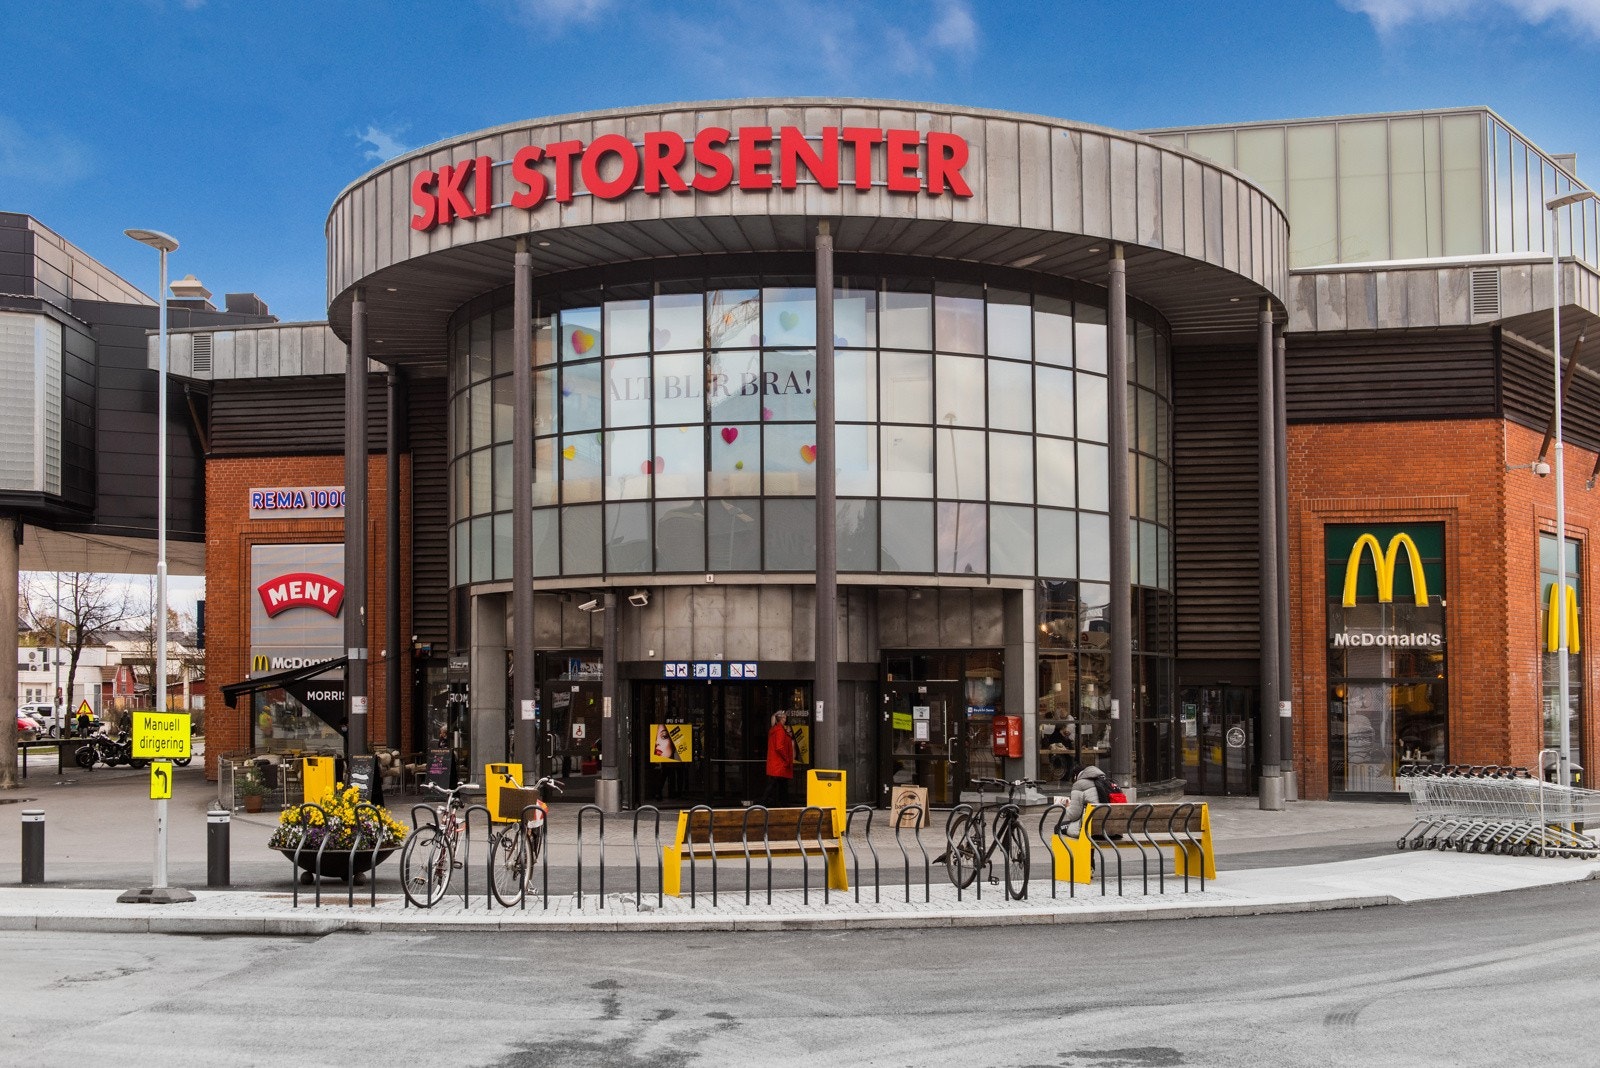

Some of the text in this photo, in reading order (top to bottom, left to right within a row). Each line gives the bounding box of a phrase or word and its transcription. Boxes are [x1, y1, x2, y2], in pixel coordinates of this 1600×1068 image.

[411, 126, 974, 232] SKI STORSENTER
[658, 373, 731, 400] BLR
[740, 369, 812, 397] BRA!
[251, 490, 305, 508] REMA
[267, 581, 338, 606] MENY
[1333, 632, 1441, 647] McDonald's
[144, 717, 180, 731] Manuell
[139, 736, 184, 753] dirigering
